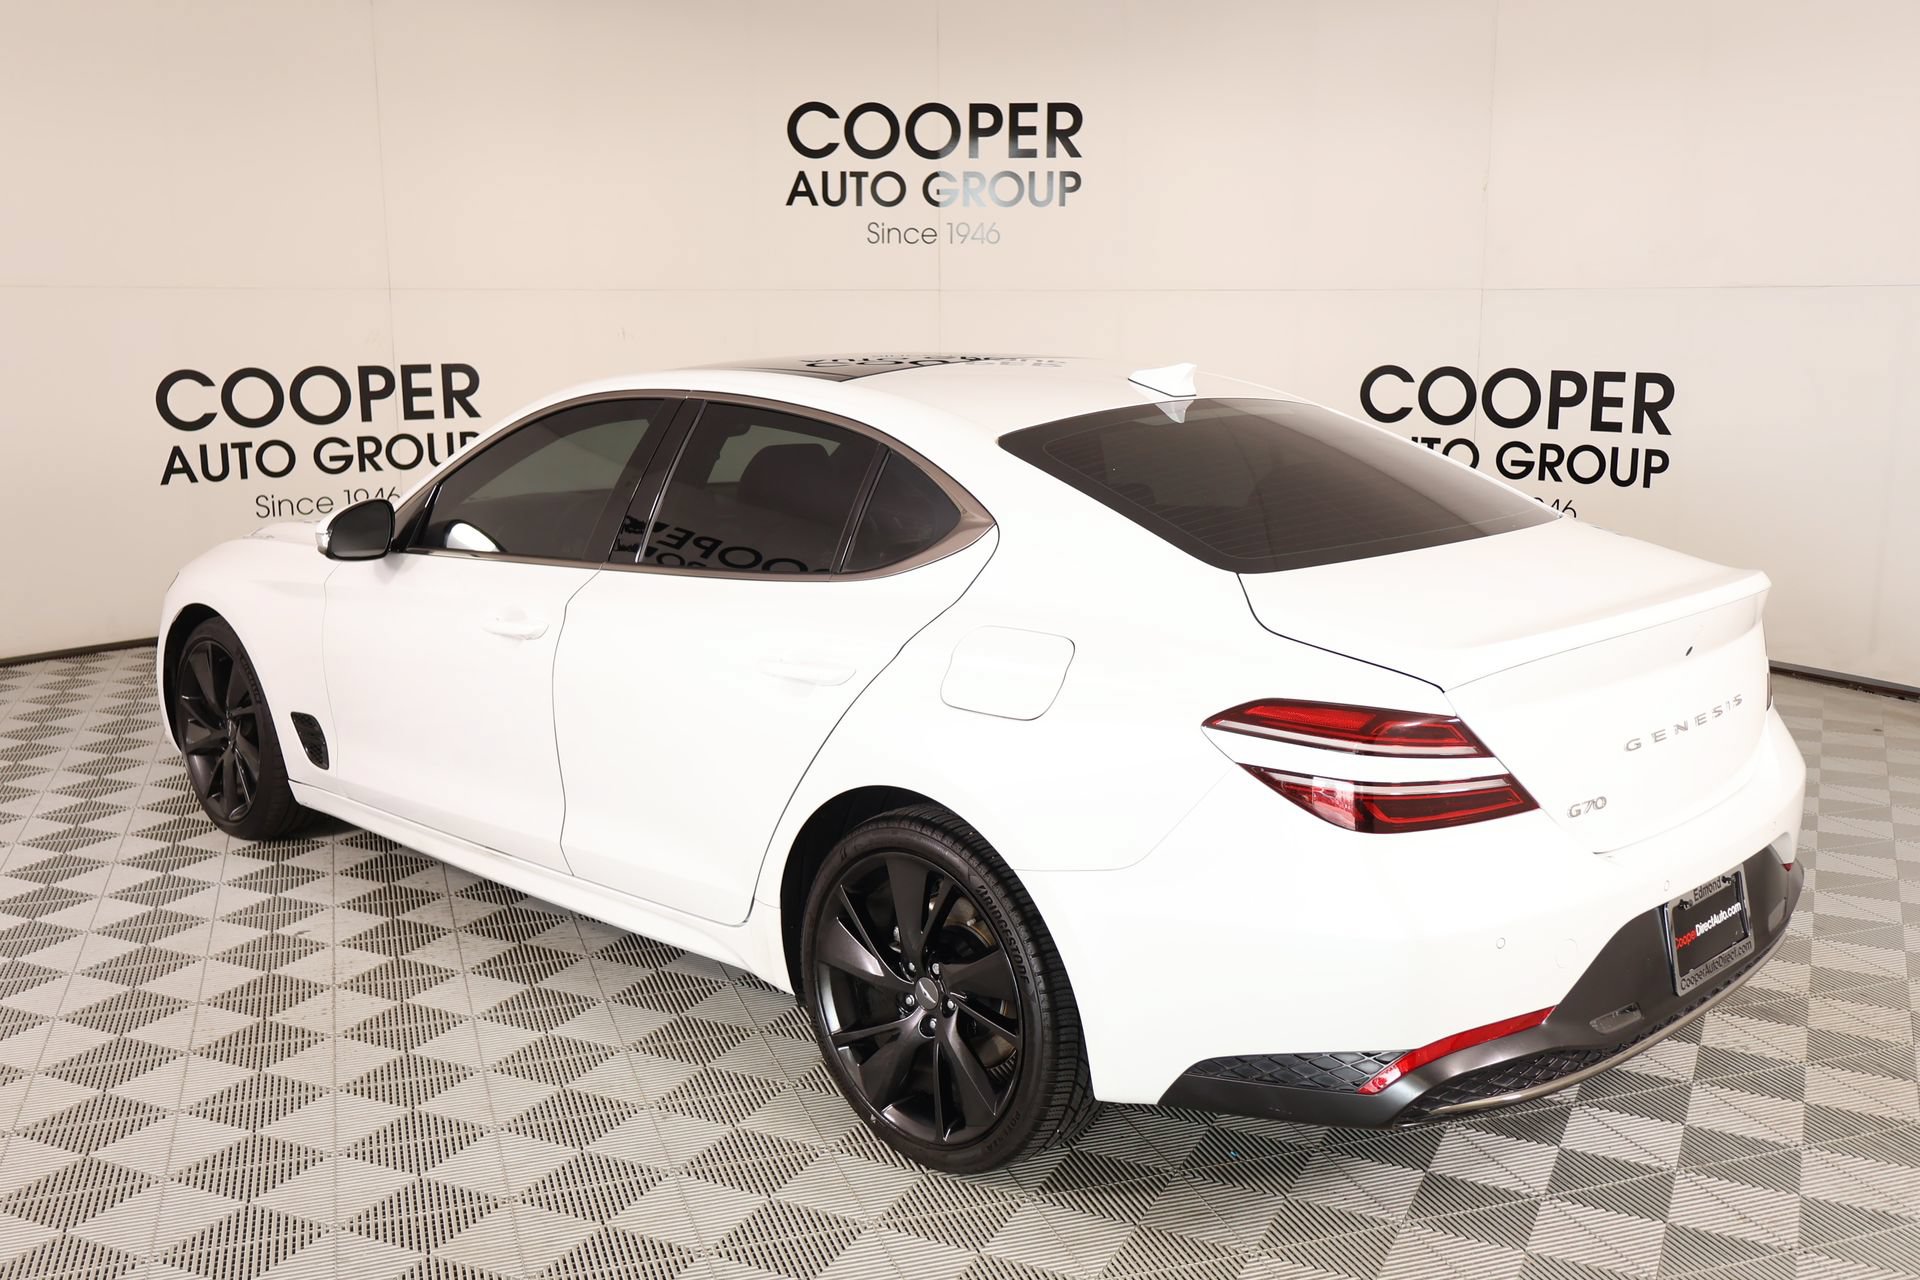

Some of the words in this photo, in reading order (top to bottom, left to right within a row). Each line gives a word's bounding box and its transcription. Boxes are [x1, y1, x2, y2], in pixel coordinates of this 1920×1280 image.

[787, 101, 1083, 160] COOPER
[786, 170, 907, 208] AUTO
[922, 170, 1082, 208] GROUP
[867, 222, 938, 245] Since
[946, 222, 1001, 245] 1946
[156, 363, 482, 432] COOPER
[1360, 364, 1675, 436] COOPER
[160, 441, 296, 486] AUTO
[1496, 440, 1670, 489] GROUP
[256, 494, 334, 519] Since
[1624, 693, 1743, 752] GENESIS
[1567, 796, 1607, 819] G70
[1693, 876, 1722, 902] Edmond
[976, 885, 1030, 985] BRIDGESTONE
